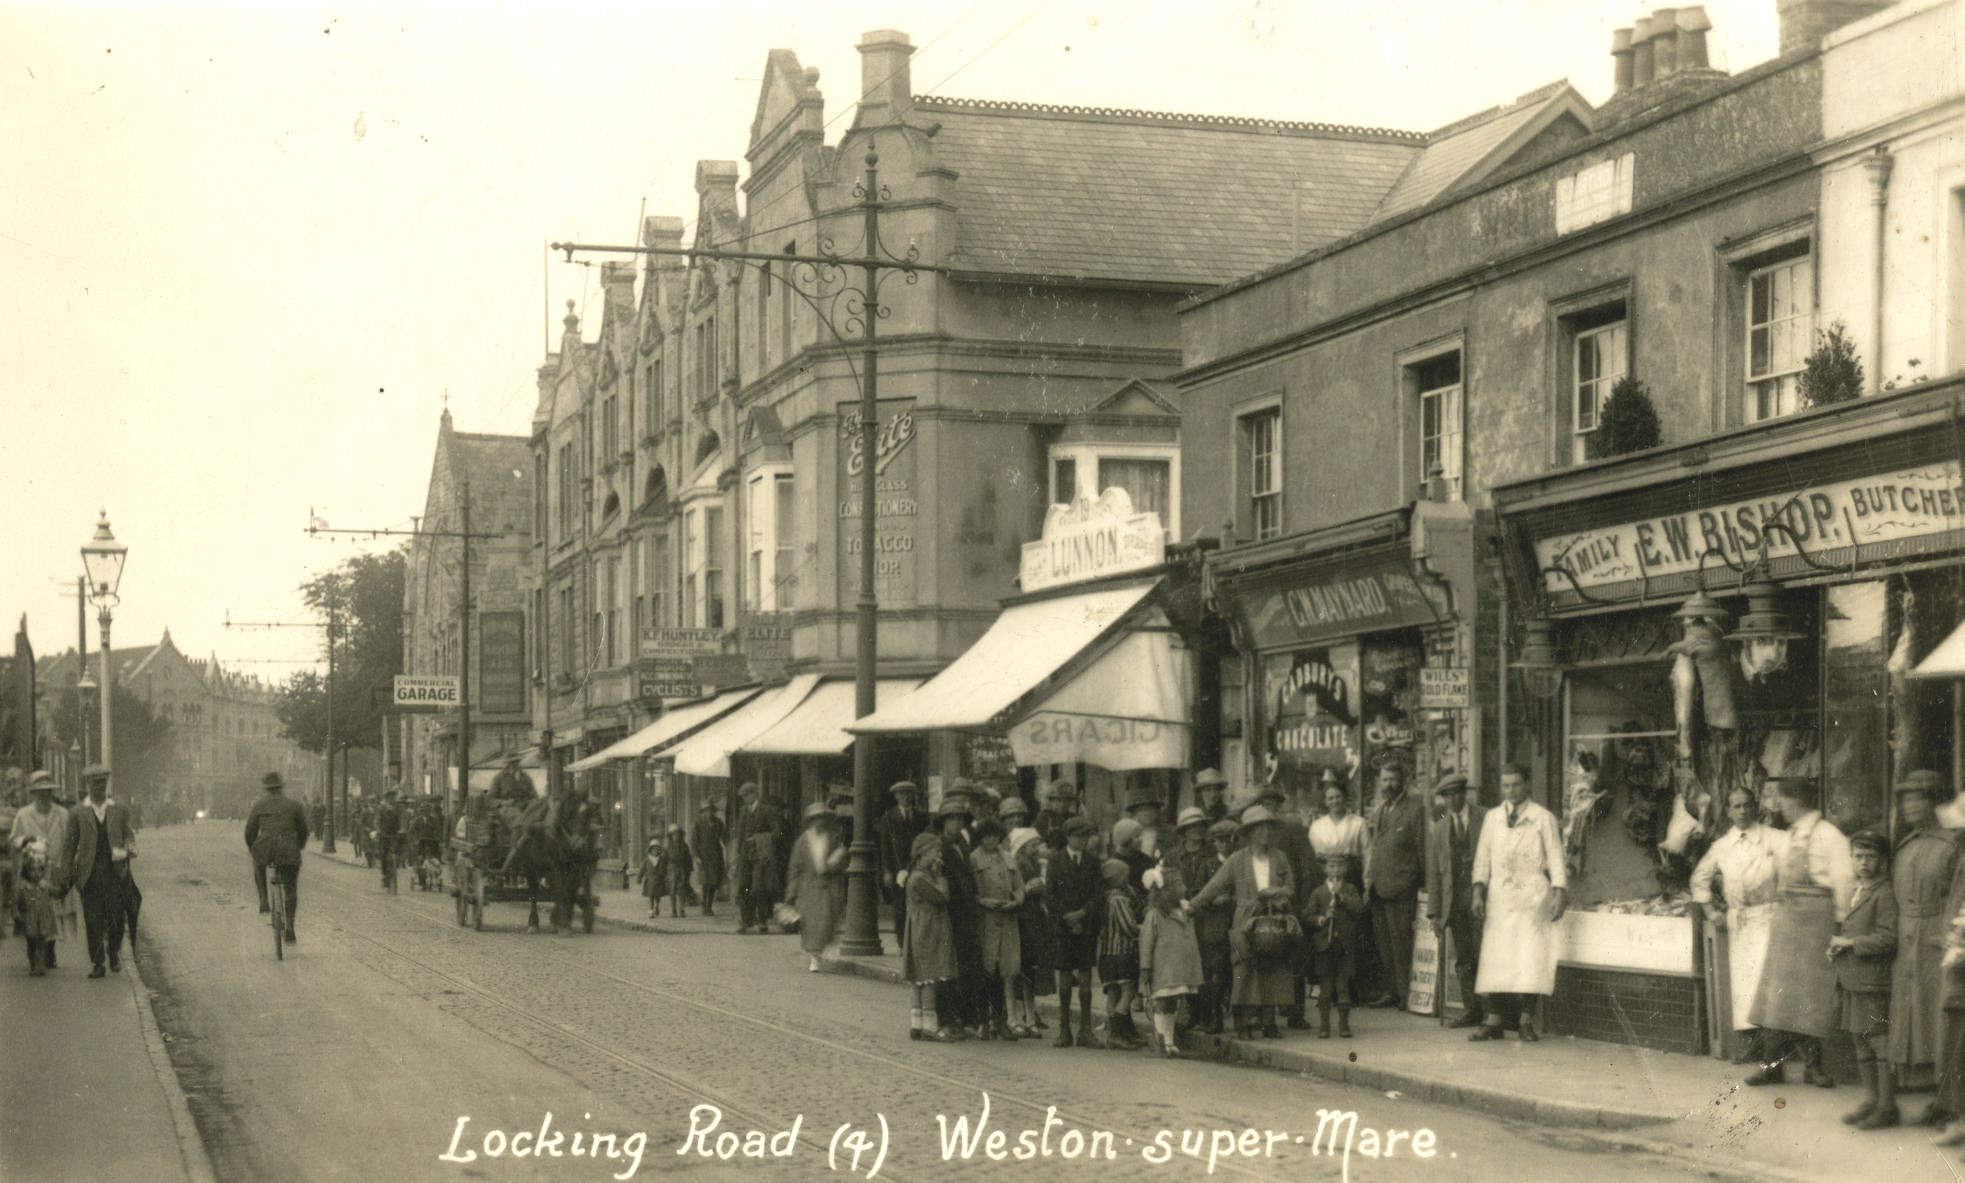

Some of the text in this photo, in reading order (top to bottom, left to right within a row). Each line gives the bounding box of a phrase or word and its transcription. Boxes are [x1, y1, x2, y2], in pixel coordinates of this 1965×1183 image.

[847, 411, 914, 476] Eite
[847, 535, 913, 554] TOACCO
[1551, 534, 1620, 583] FAMILY
[397, 679, 455, 687] COMMERCIAL
[642, 684, 698, 697] CYCLISTS
[397, 687, 457, 701] GARAGE
[1276, 724, 1348, 752] CHOCOLATE
